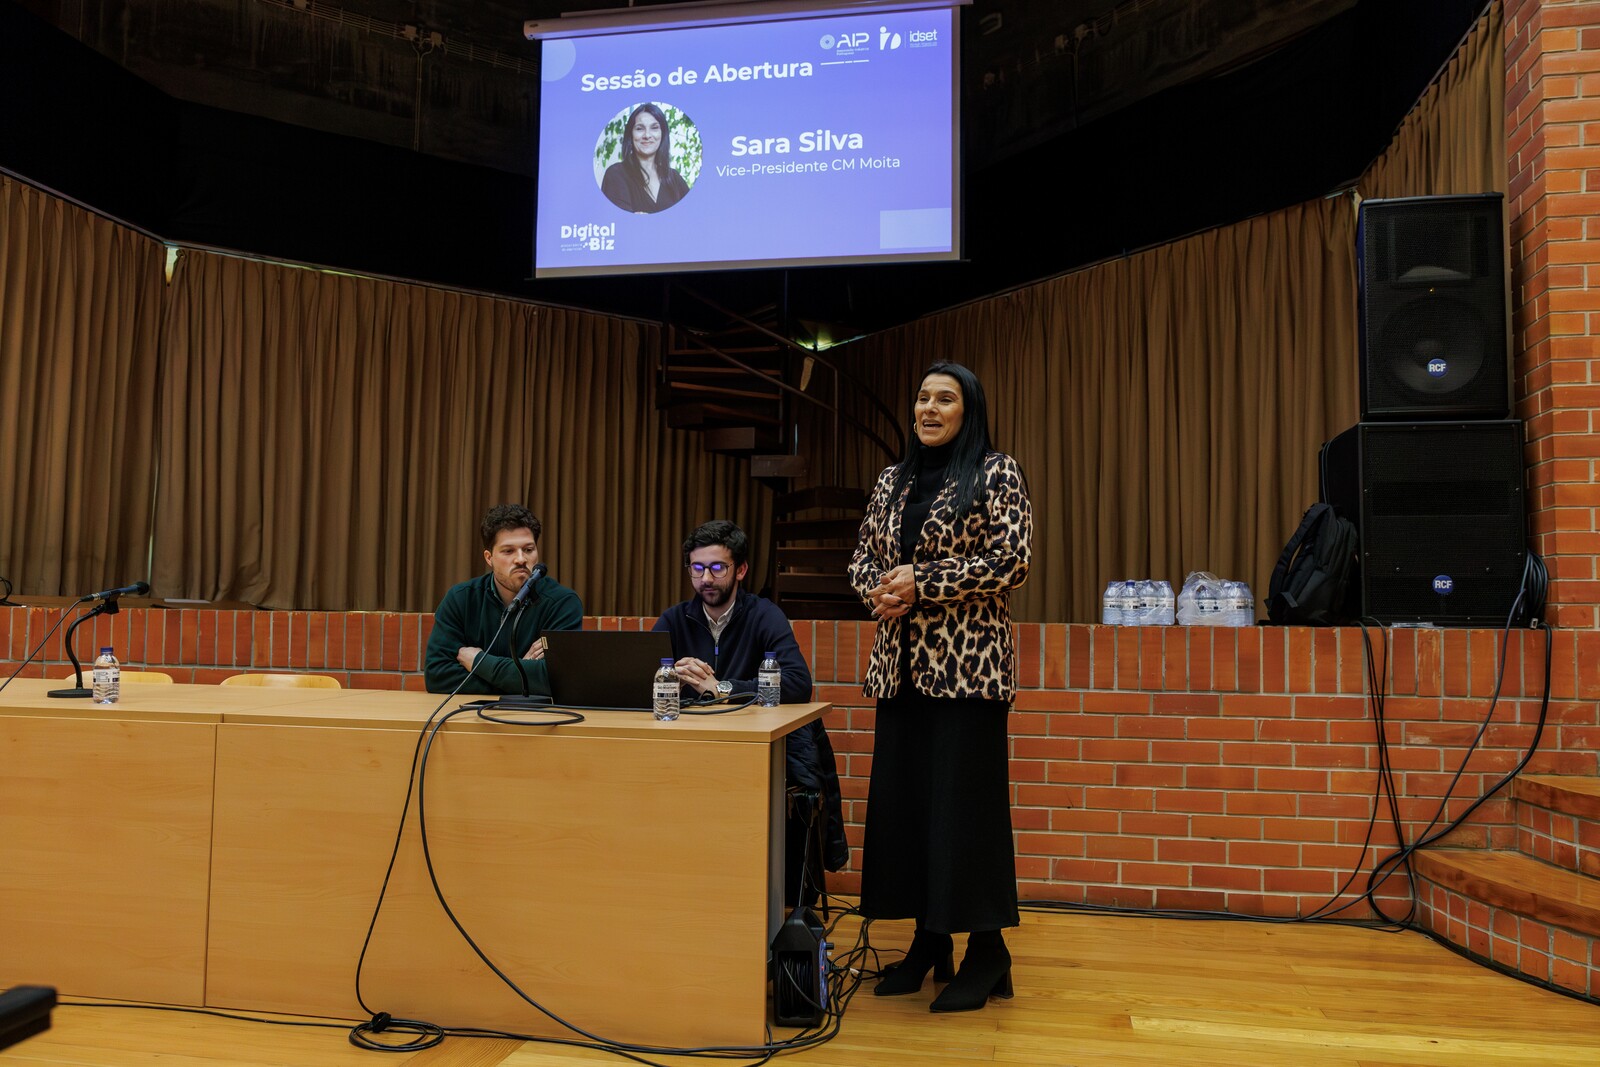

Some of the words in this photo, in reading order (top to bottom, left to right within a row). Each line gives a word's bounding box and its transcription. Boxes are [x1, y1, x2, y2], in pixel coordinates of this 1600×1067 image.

[836, 32, 870, 48] AIP
[909, 29, 938, 42] idset
[581, 69, 661, 92] Sessão
[667, 67, 698, 86] de
[703, 61, 813, 83] Abertura
[731, 135, 790, 157] Sara
[798, 129, 863, 153] Silva
[716, 160, 828, 177] Vice-Presidente
[831, 158, 855, 171] CM
[859, 155, 901, 169] Moita
[560, 222, 616, 242] Digital
[590, 236, 615, 251] Biz
[1428, 363, 1447, 372] RCF
[1434, 580, 1453, 589] RCF
